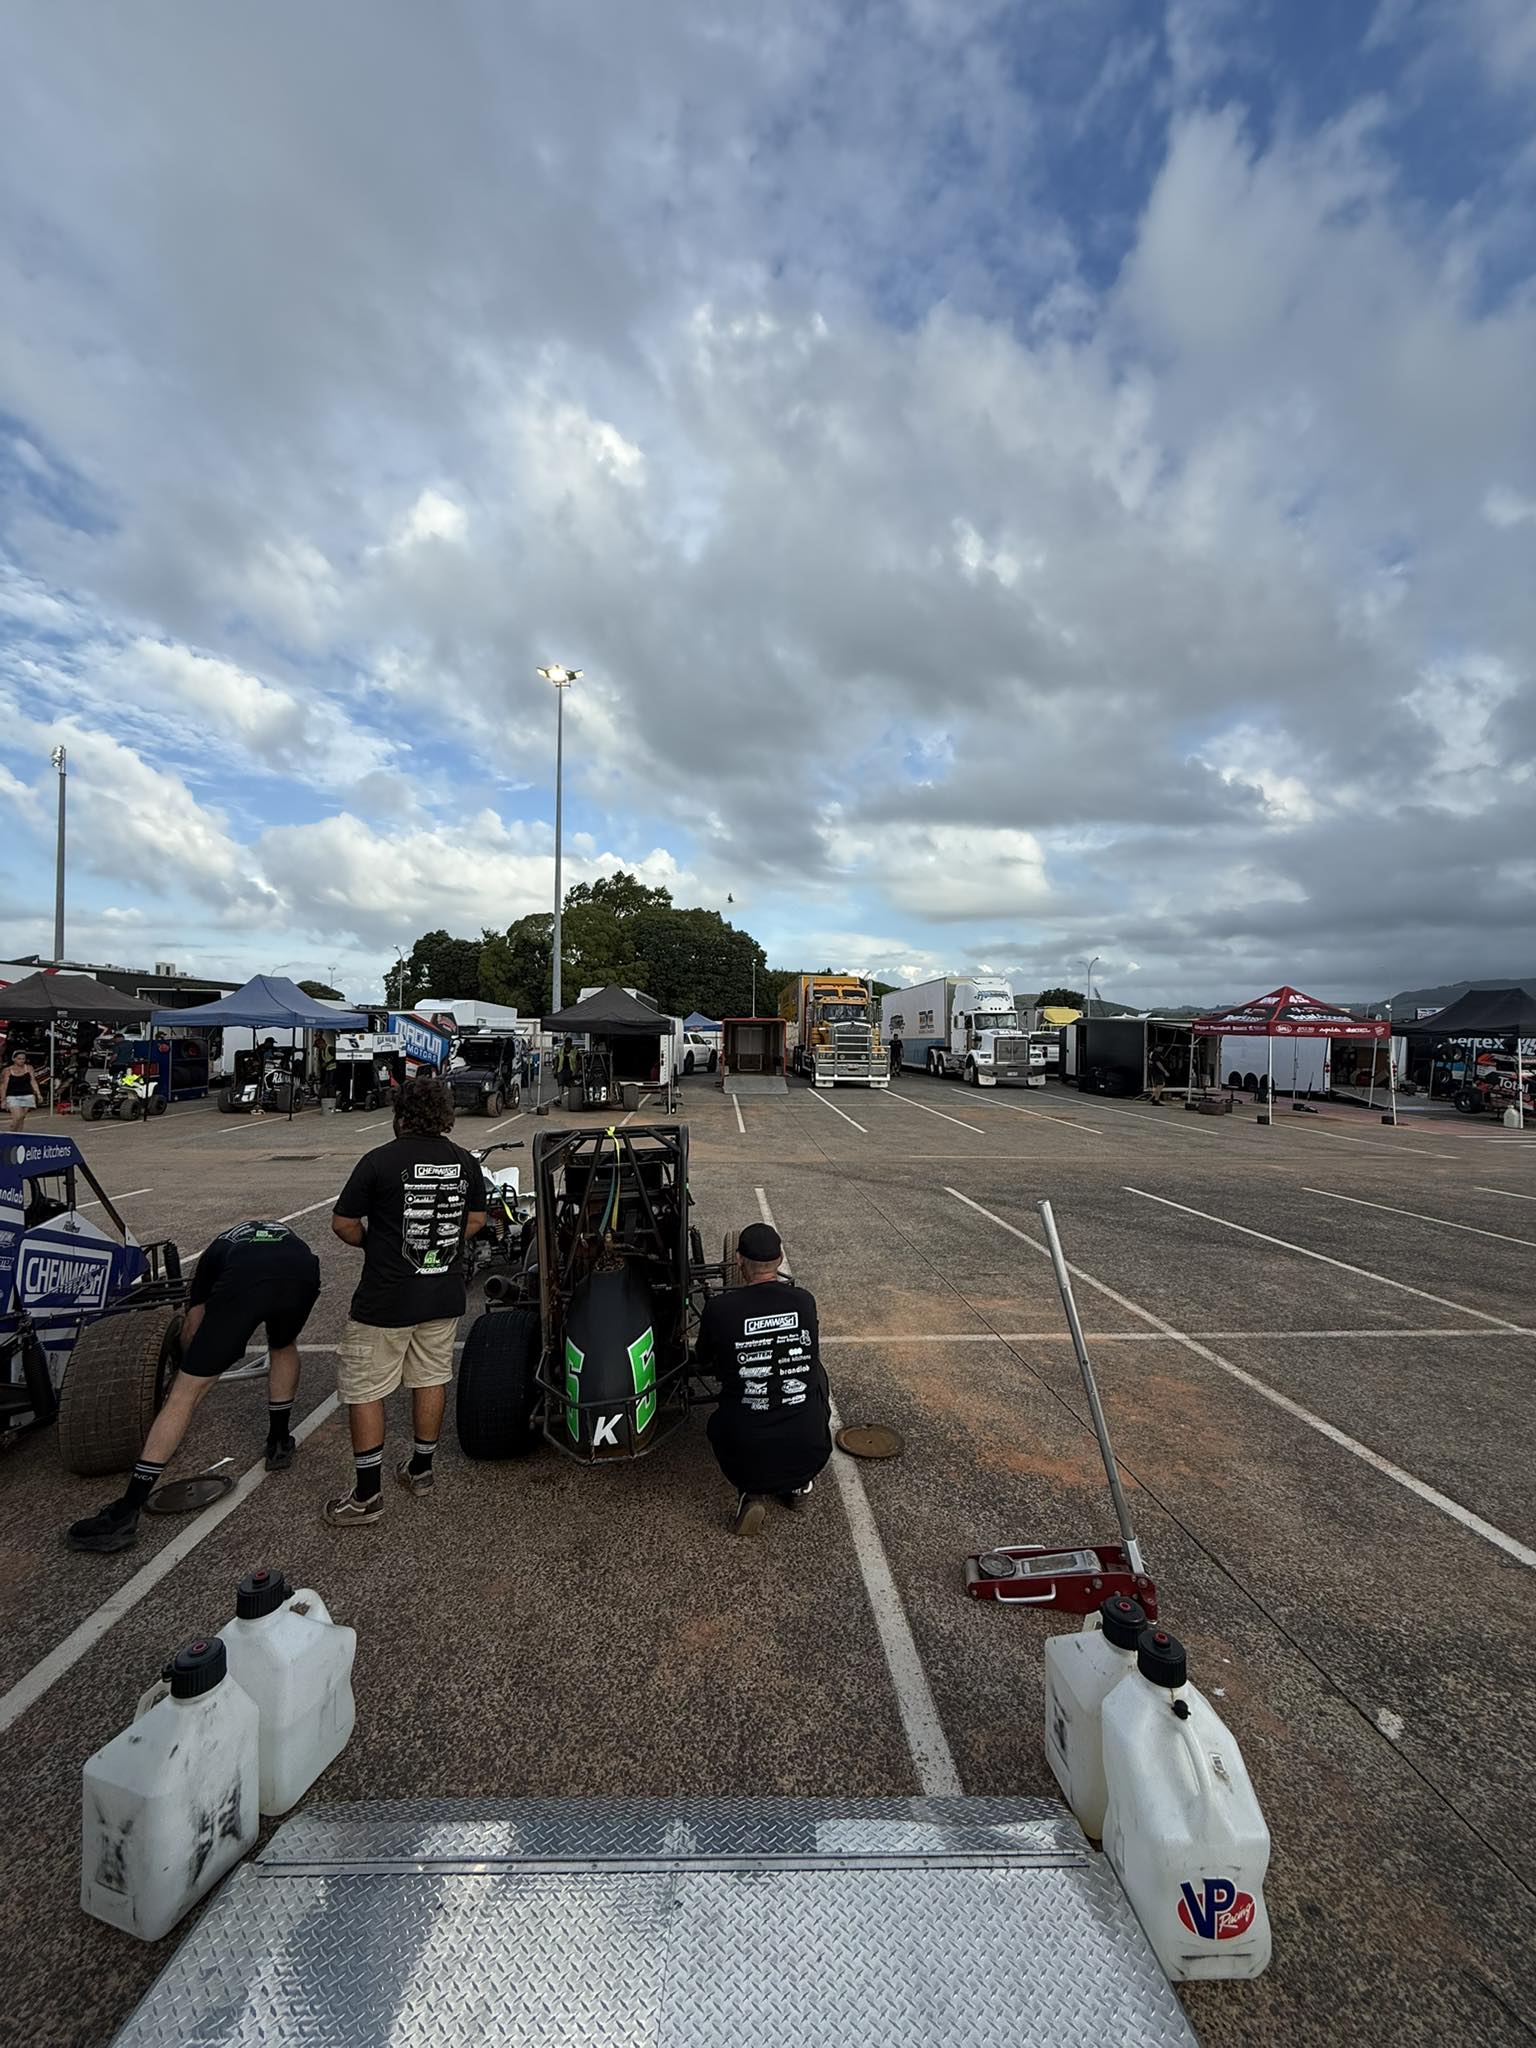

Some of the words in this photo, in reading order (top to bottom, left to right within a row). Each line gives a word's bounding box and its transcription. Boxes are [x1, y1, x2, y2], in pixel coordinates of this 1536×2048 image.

[406, 1042, 437, 1063] MOTORS
[26, 1146, 41, 1160] elite
[43, 1145, 71, 1159] kitchens
[0, 1187, 24, 1204] ndlab
[26, 1257, 105, 1296] CHEMWASH
[748, 1316, 794, 1332] CHEMWASH
[780, 1364, 810, 1375] brandlab
[593, 1413, 623, 1446] K
[1180, 1877, 1236, 1940] VP
[1218, 1903, 1252, 1933] Racing
